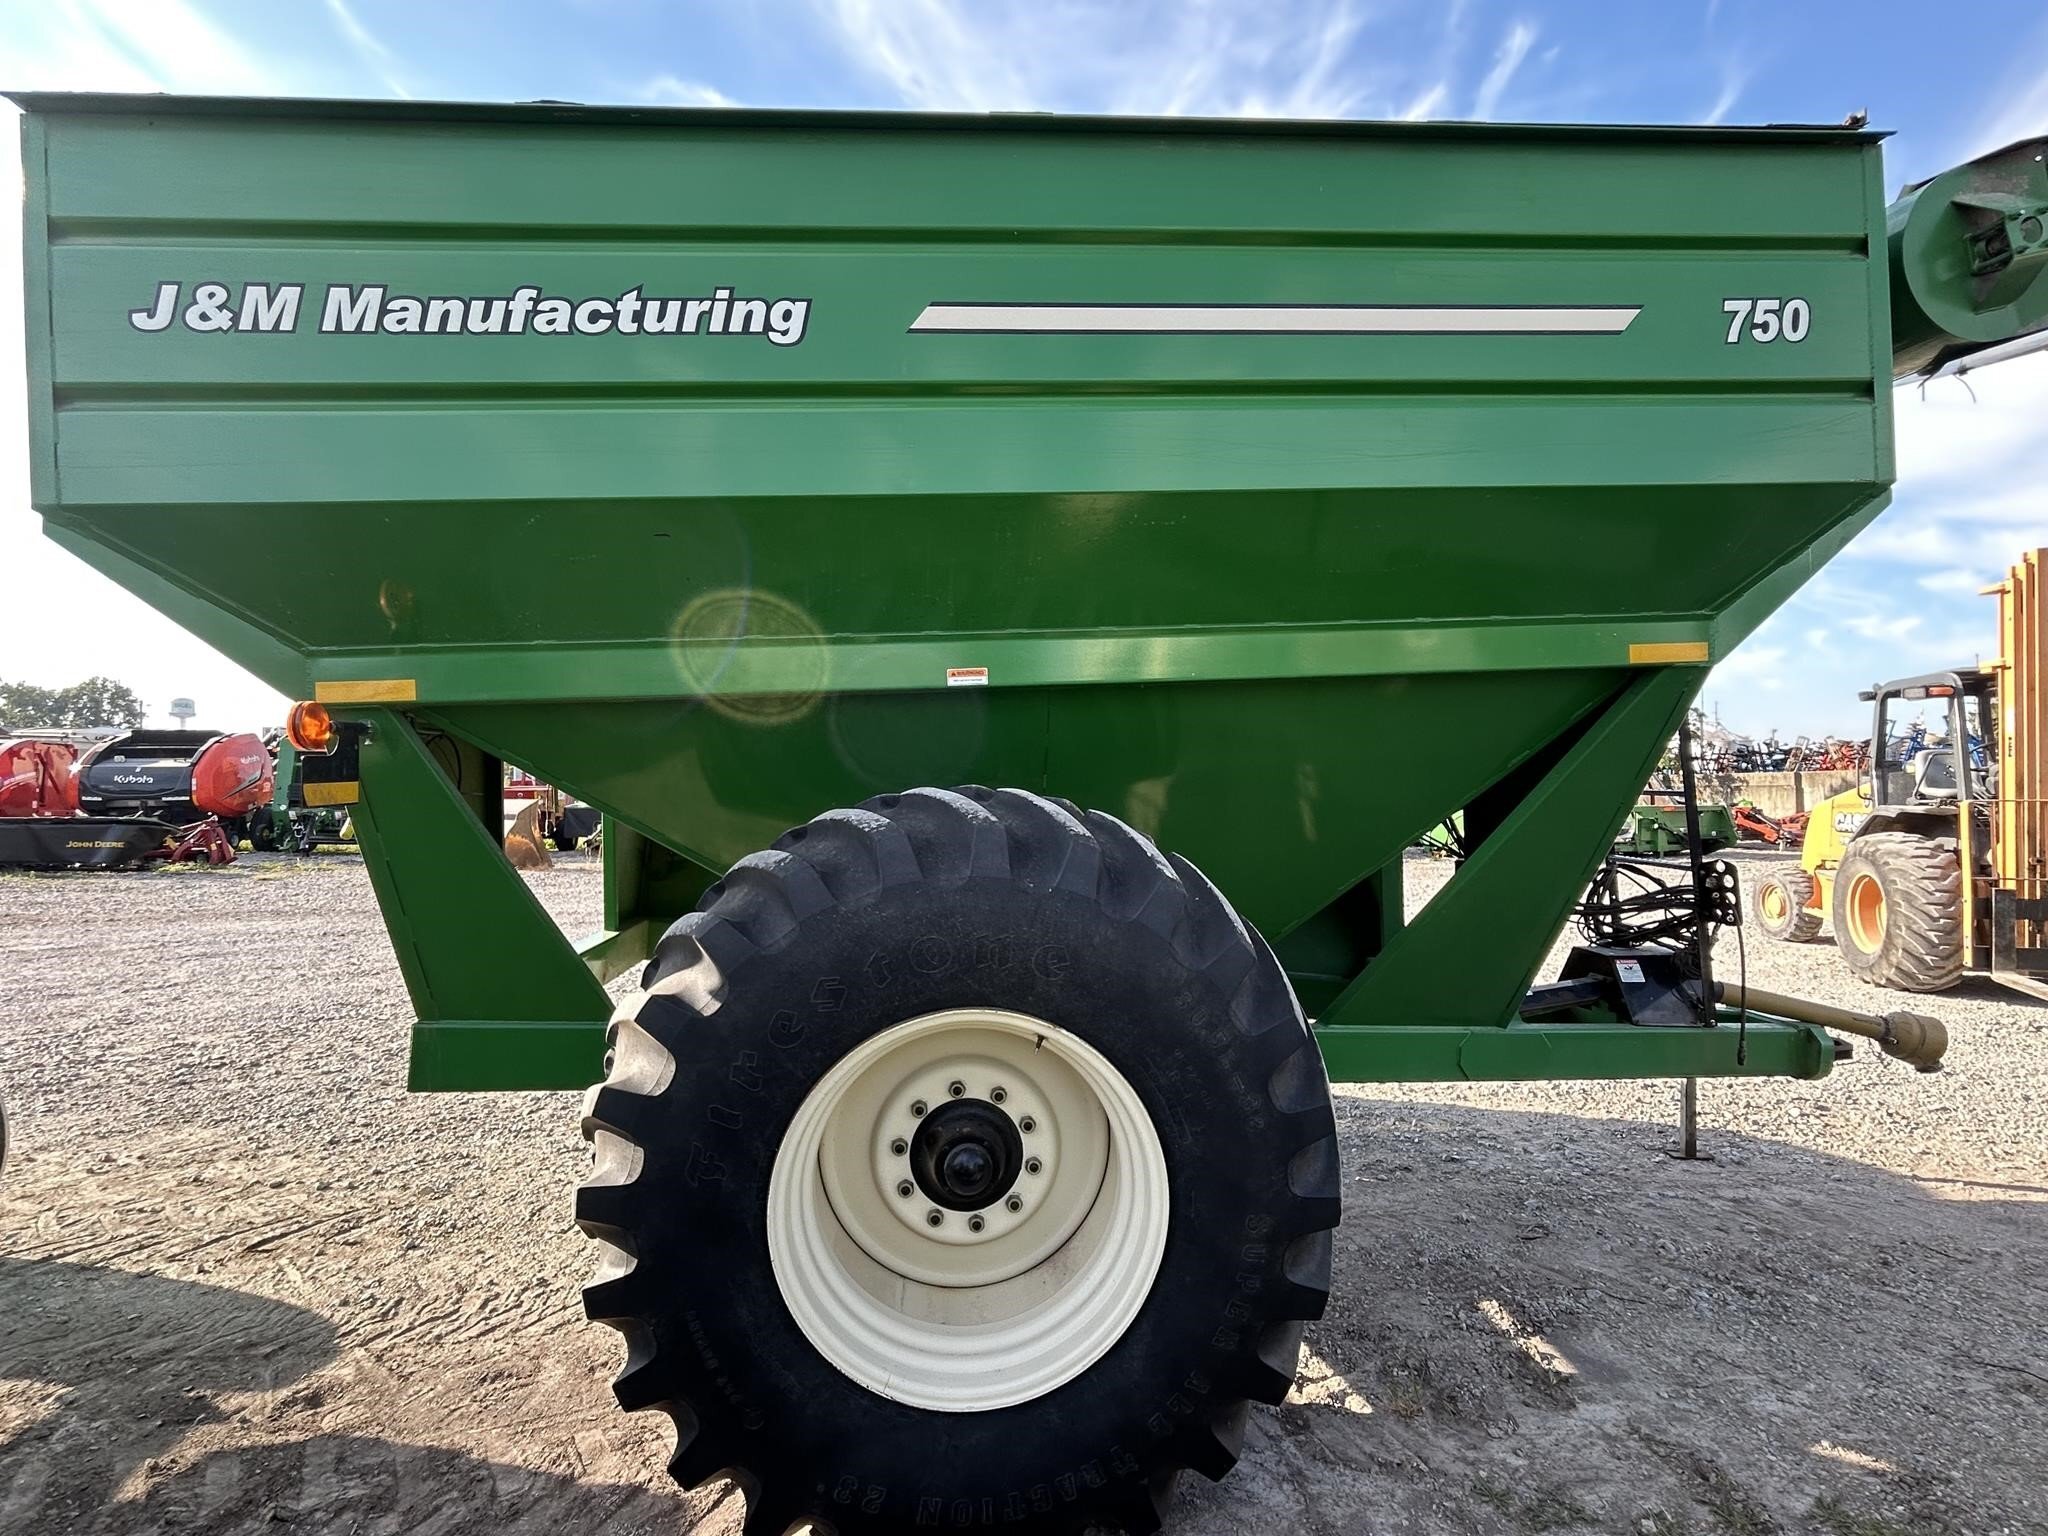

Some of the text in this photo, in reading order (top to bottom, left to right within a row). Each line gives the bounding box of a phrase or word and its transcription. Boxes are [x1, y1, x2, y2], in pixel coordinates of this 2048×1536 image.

[319, 284, 812, 347] Manufacturing
[1722, 297, 1812, 344] 750
[113, 774, 154, 784] Kubota
[65, 840, 126, 849] JOHN DEERE
[685, 932, 1070, 1188] Firestone
[1209, 1212, 1276, 1352] SUPER
[915, 1445, 1139, 1527] TRACTION
